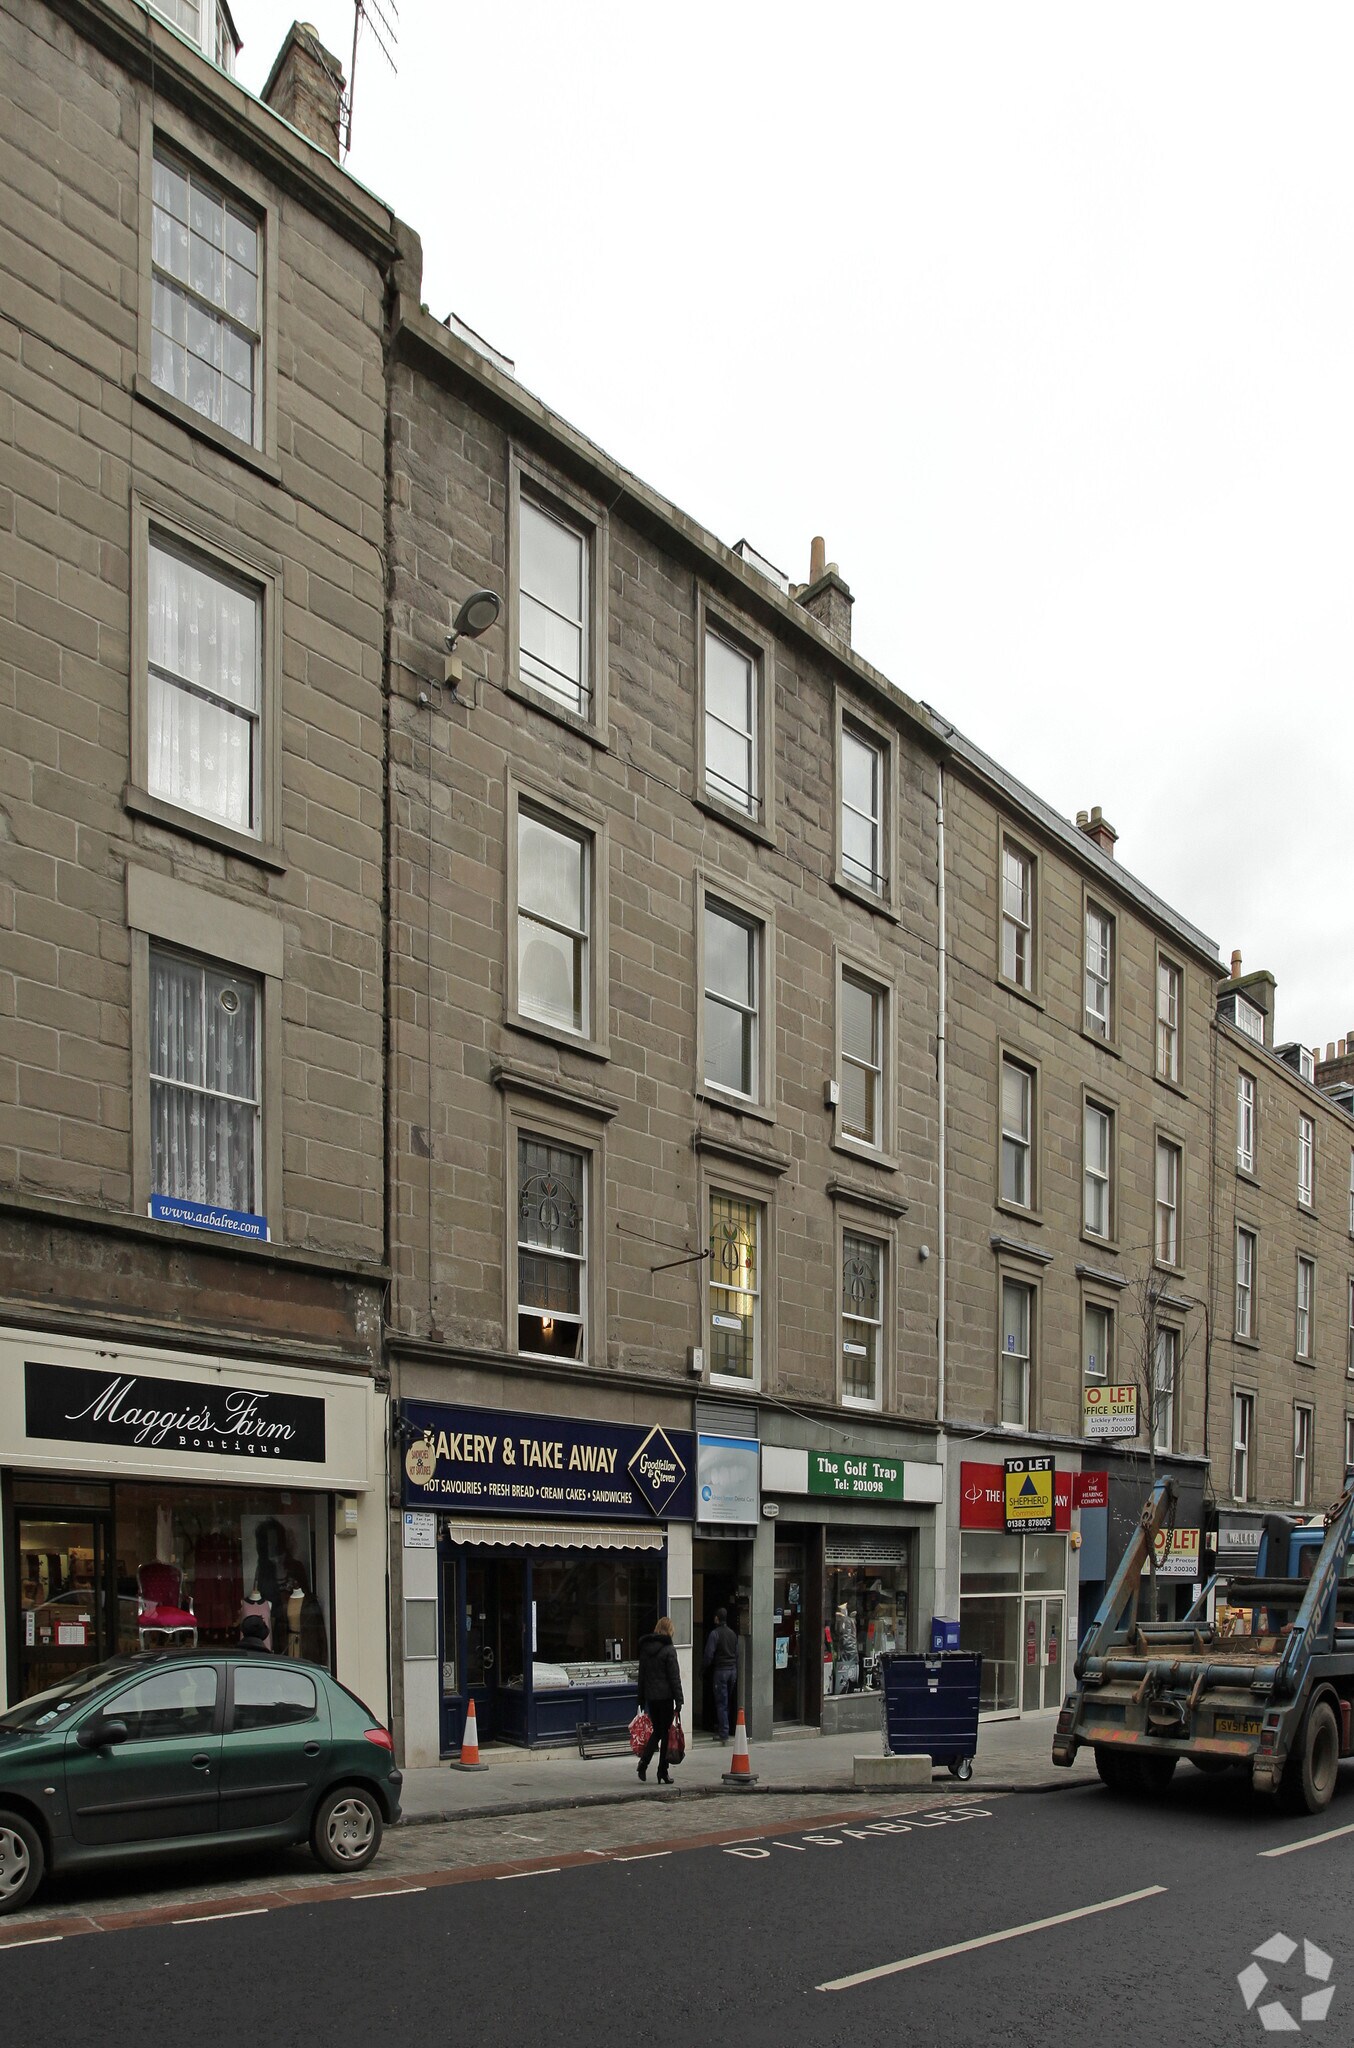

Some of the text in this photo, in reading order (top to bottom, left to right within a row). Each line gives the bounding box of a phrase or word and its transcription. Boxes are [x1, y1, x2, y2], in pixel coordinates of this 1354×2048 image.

[159, 1205, 260, 1236] www.aabalree.com
[1085, 1387, 1135, 1405] O LET
[65, 1376, 296, 1446] Maggie's Farm
[1112, 1404, 1135, 1414] SUITE
[179, 1436, 281, 1454] Boutique
[502, 1437, 516, 1466] &
[519, 1439, 563, 1470] TAKE
[568, 1444, 618, 1474] AWAY
[640, 1453, 677, 1474] Goodfellow
[817, 1457, 897, 1482] The Golf Trap
[1006, 1458, 1051, 1473] TO LET
[652, 1469, 676, 1489] Steven
[833, 1478, 884, 1493] Tel: 201098
[441, 1480, 482, 1495] SAVOURIES
[488, 1483, 511, 1497] FRESH
[511, 1484, 535, 1498] BREAD
[540, 1486, 564, 1500] CREAM
[565, 1488, 587, 1501] CAKES
[592, 1490, 633, 1504] SANDWICHES
[985, 1489, 1001, 1503] THE
[1009, 1495, 1049, 1507] SHEPHERD
[1080, 1497, 1105, 1505] COMPANY
[1012, 1508, 1047, 1518] Commercial
[1007, 1518, 1051, 1528] 01382 878005
[1173, 1529, 1199, 1549] LET
[723, 1808, 993, 1859] DISABLED
